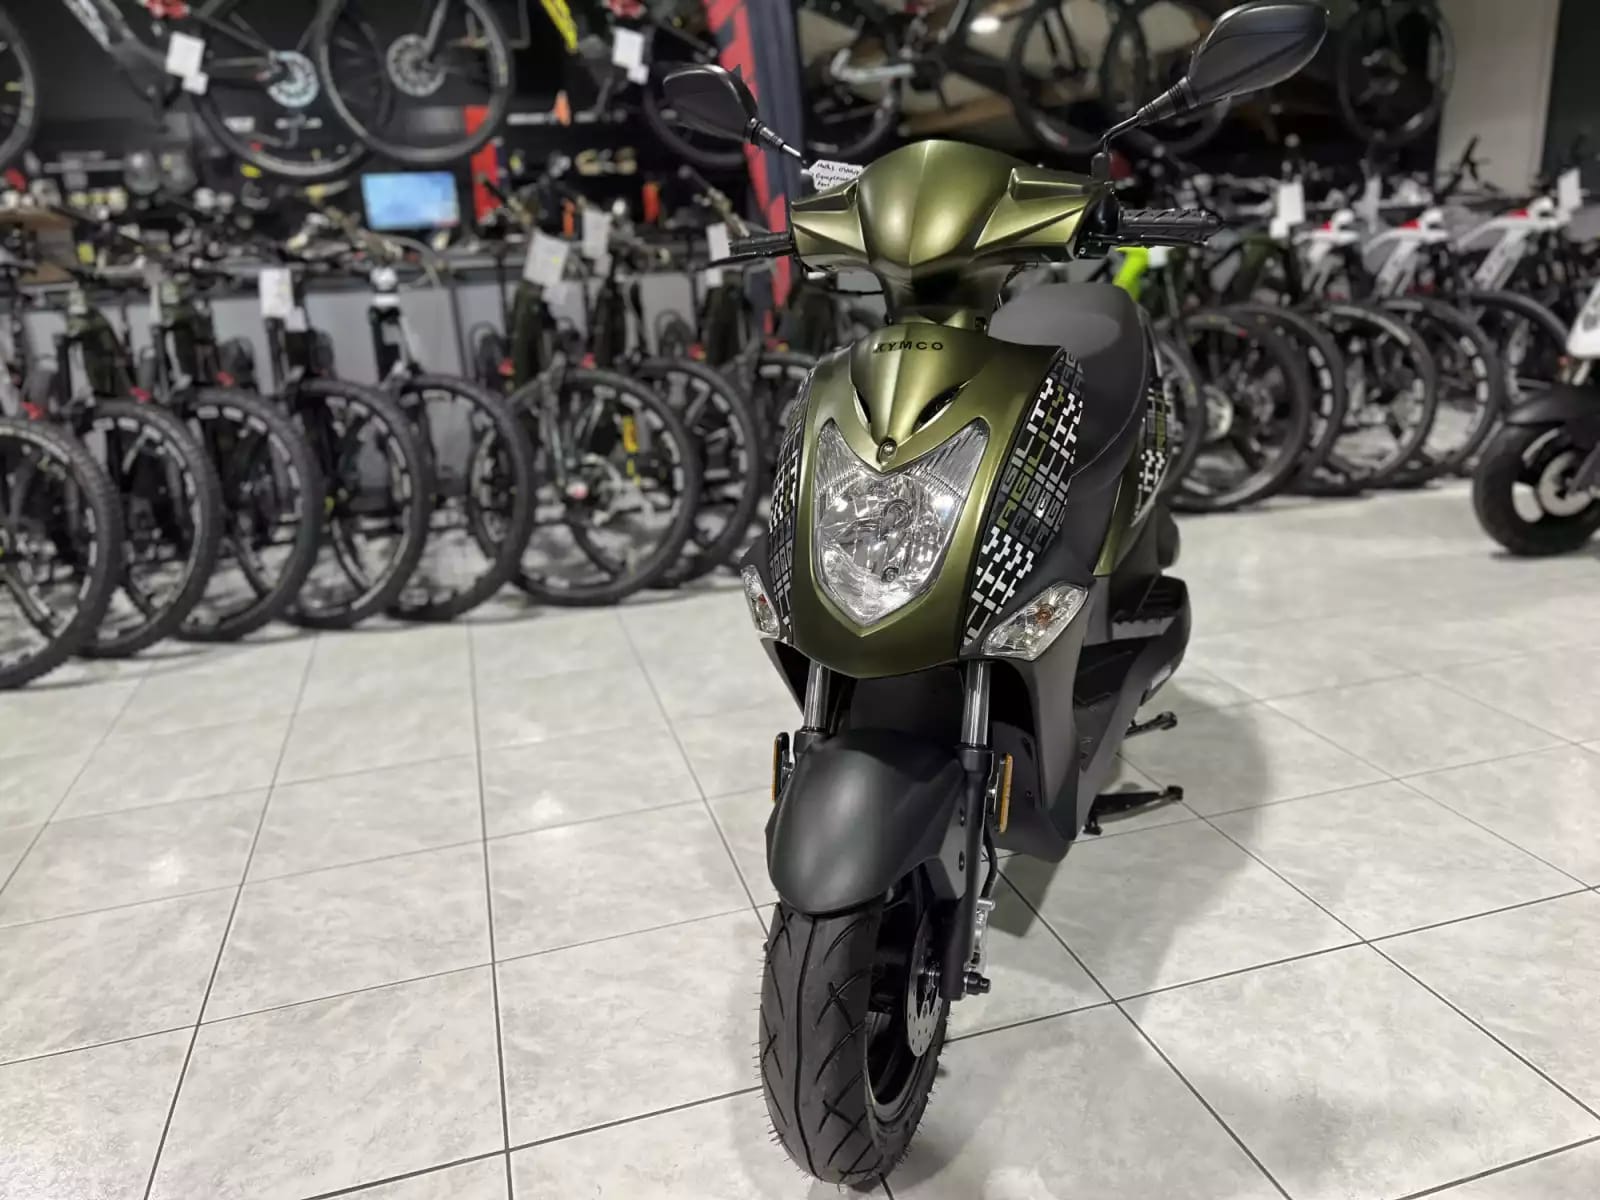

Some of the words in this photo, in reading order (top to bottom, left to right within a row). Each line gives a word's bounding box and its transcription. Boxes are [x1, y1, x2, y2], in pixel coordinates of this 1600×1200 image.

[872, 340, 944, 353] KYMCO
[996, 384, 1065, 530] AGILITY
[1008, 392, 1075, 538] AGILITY
